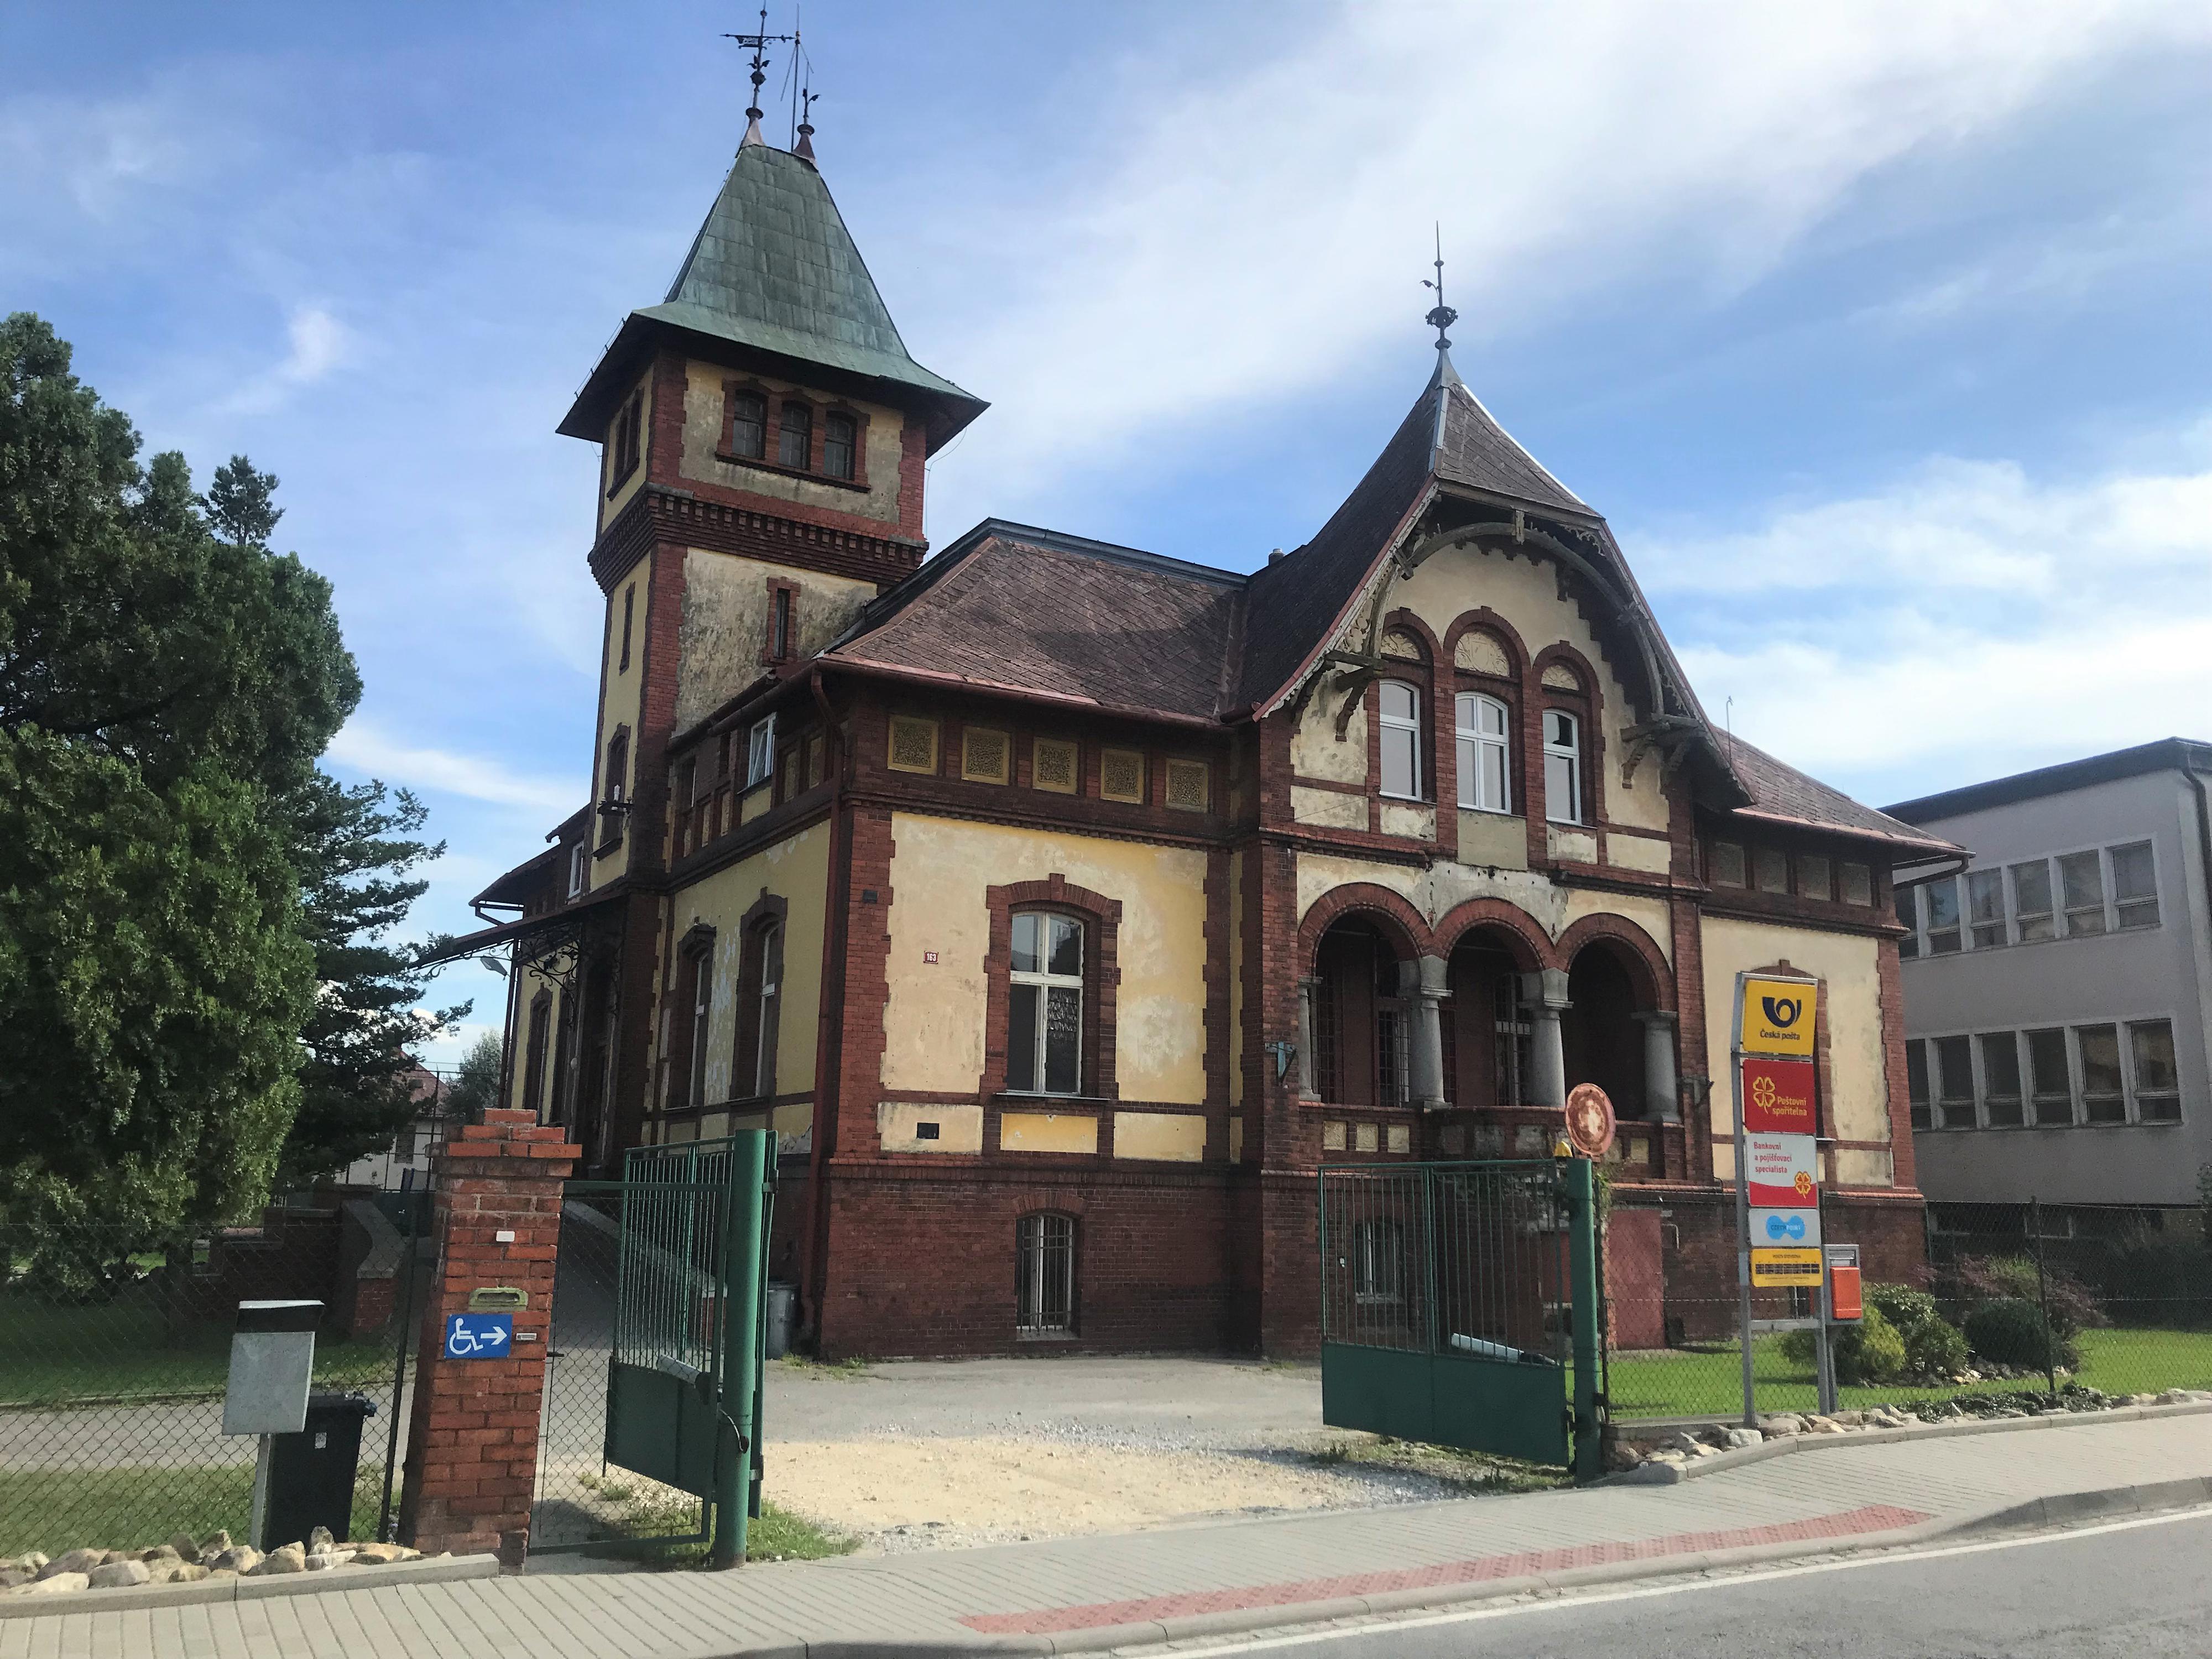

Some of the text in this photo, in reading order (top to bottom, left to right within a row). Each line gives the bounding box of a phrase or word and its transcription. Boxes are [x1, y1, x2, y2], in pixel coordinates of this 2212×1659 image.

[927, 953, 936, 962] 163
[1760, 1029, 1801, 1041] Česká pošta
[1777, 1096, 1807, 1106] Poštovní
[1772, 1107, 1807, 1117] spořitelna
[1754, 1141, 1781, 1150] Bankovní
[1760, 1153, 1792, 1162] pojišťovací
[1755, 1165, 1787, 1173] specialista
